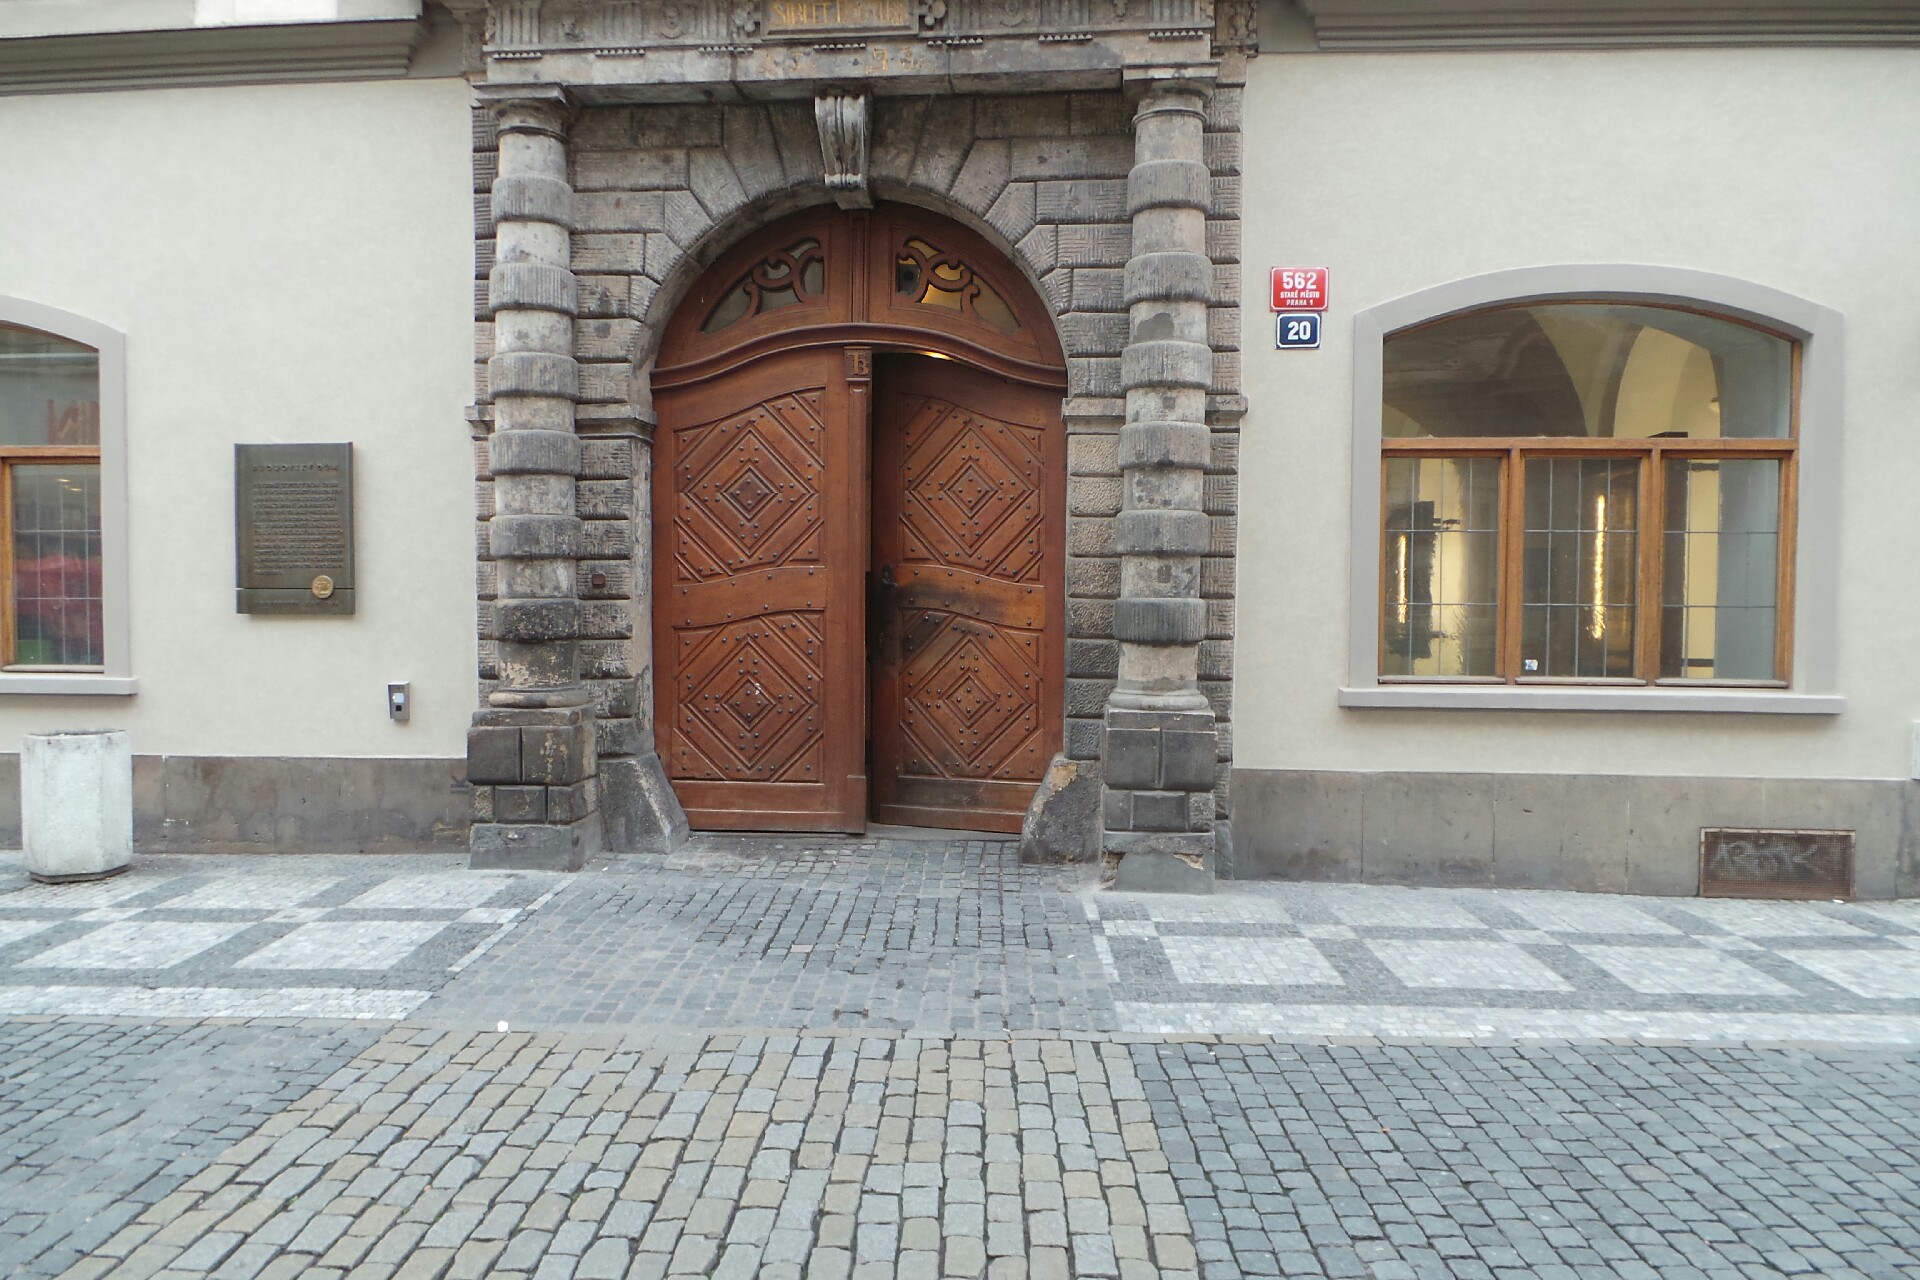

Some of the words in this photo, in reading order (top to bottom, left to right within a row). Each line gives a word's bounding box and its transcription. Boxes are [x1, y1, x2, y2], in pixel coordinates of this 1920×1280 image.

[1282, 271, 1317, 290] 562
[1280, 289, 1298, 299] STARÉ
[1300, 289, 1320, 299] MĚSTO
[1287, 320, 1311, 340] 20
